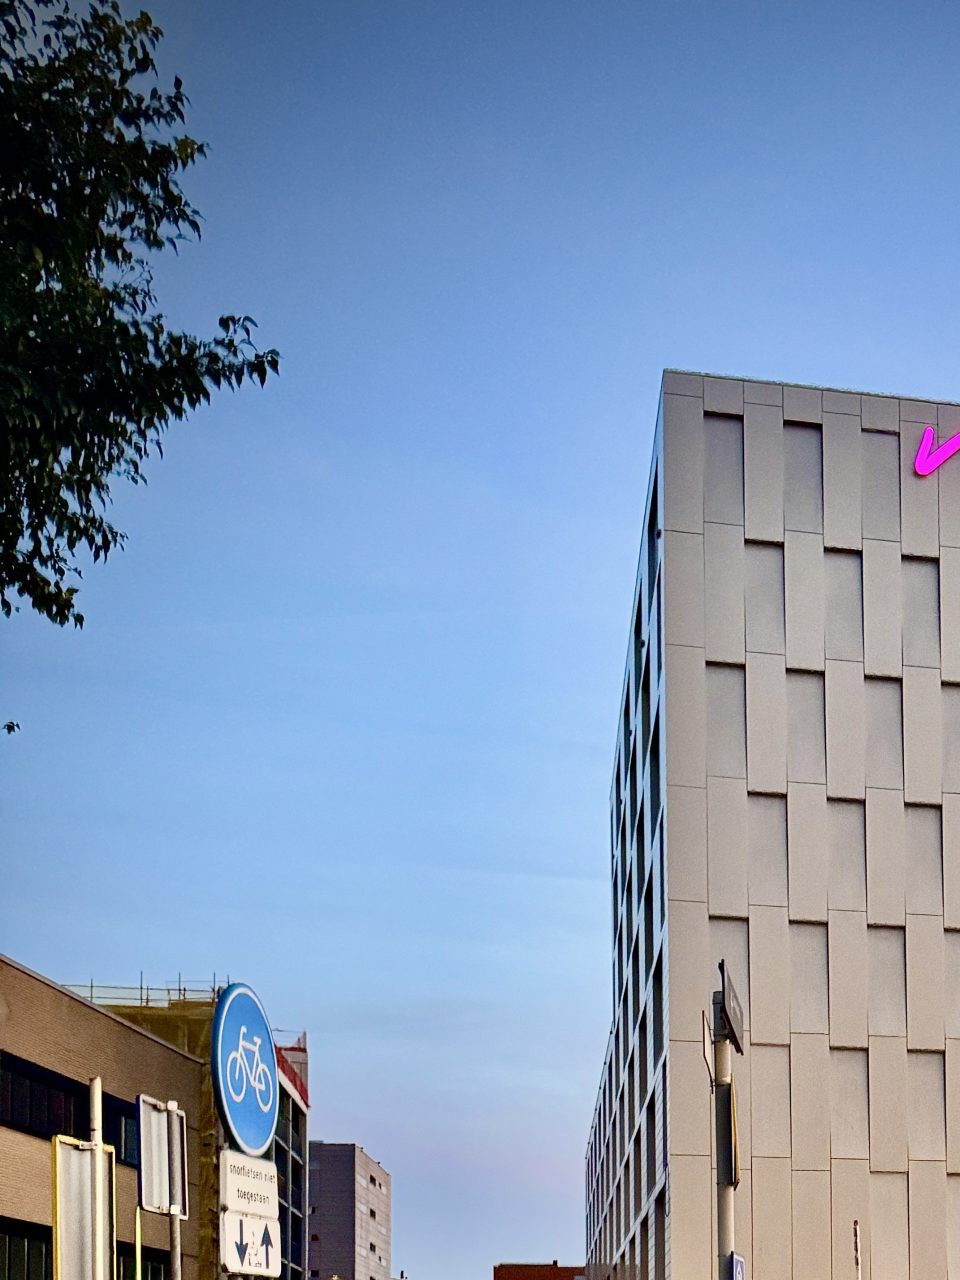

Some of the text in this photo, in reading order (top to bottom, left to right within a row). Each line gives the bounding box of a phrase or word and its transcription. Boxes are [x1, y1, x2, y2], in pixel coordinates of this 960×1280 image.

[229, 1163, 276, 1184] snorfietsen niet
[237, 1187, 270, 1205] toegestaan
